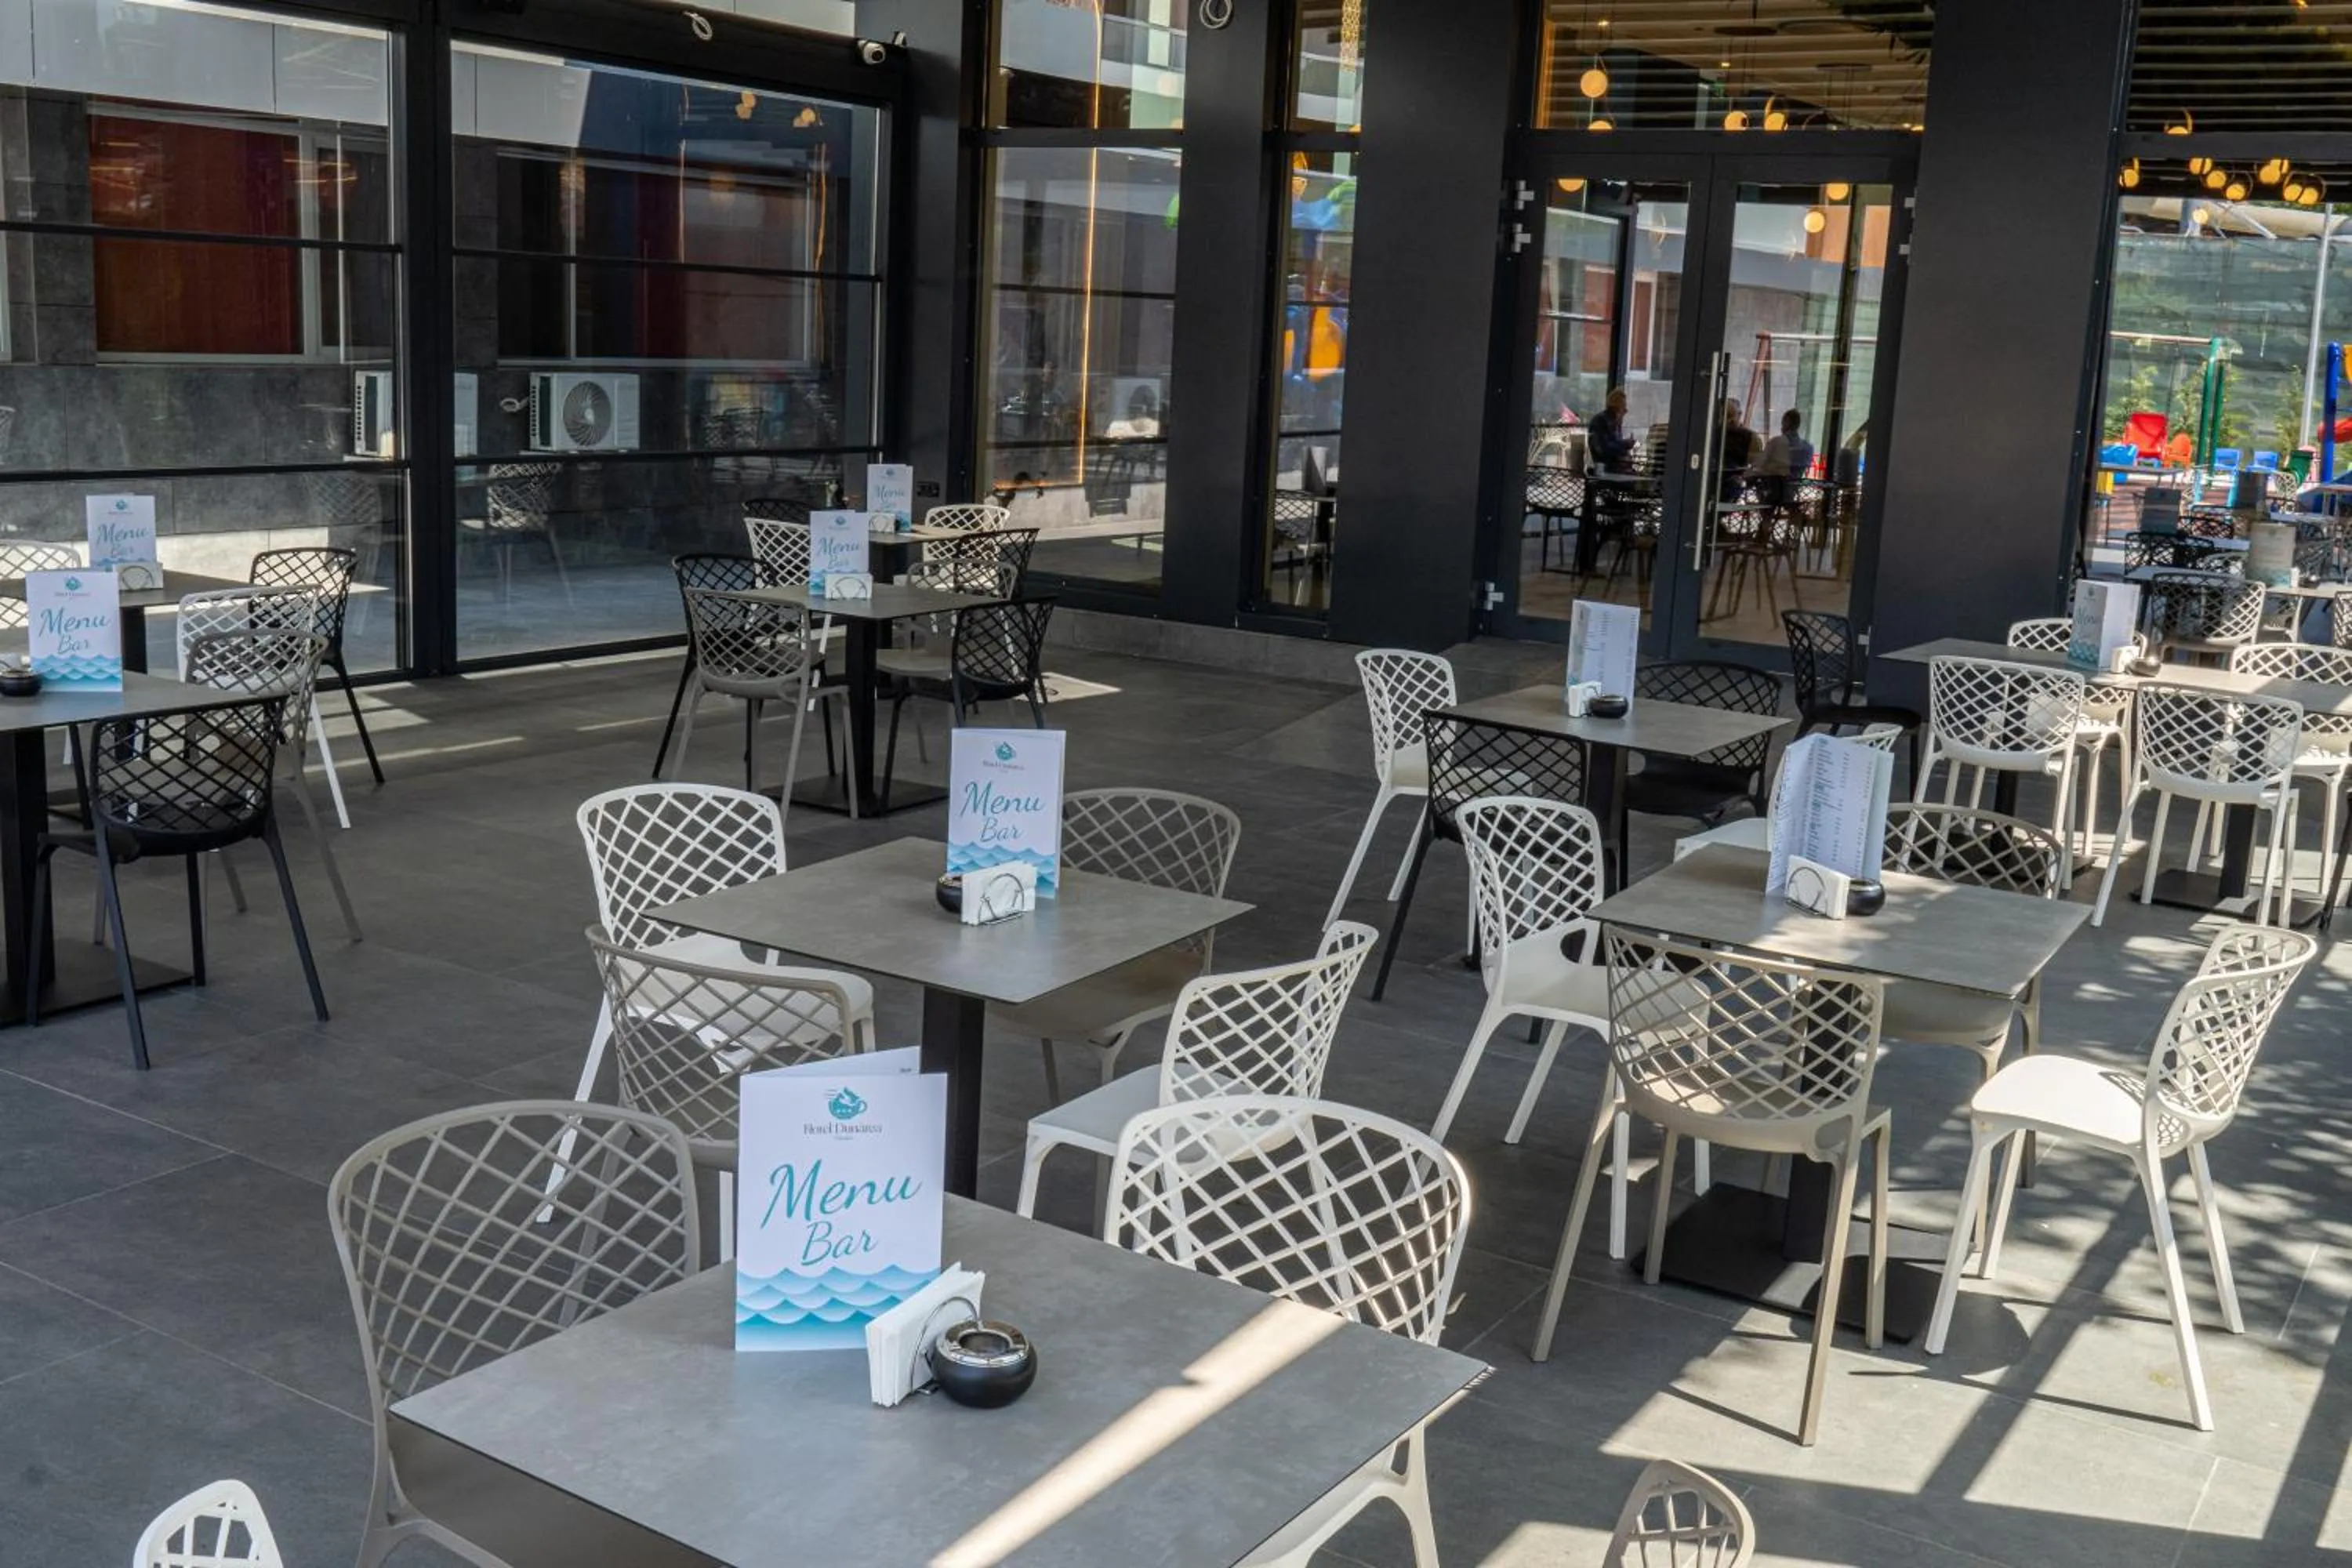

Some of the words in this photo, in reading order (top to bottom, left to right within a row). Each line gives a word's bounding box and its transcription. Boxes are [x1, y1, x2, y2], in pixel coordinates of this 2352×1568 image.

[96, 523, 149, 547] Menu
[816, 537, 861, 556] Menu
[39, 606, 111, 637] Menu
[57, 634, 90, 655] Bar
[960, 781, 1046, 817] Menu
[981, 817, 1024, 843] Bar
[803, 1121, 833, 1135] Hotel
[760, 1159, 922, 1229] Menu
[800, 1220, 878, 1266] Bar
